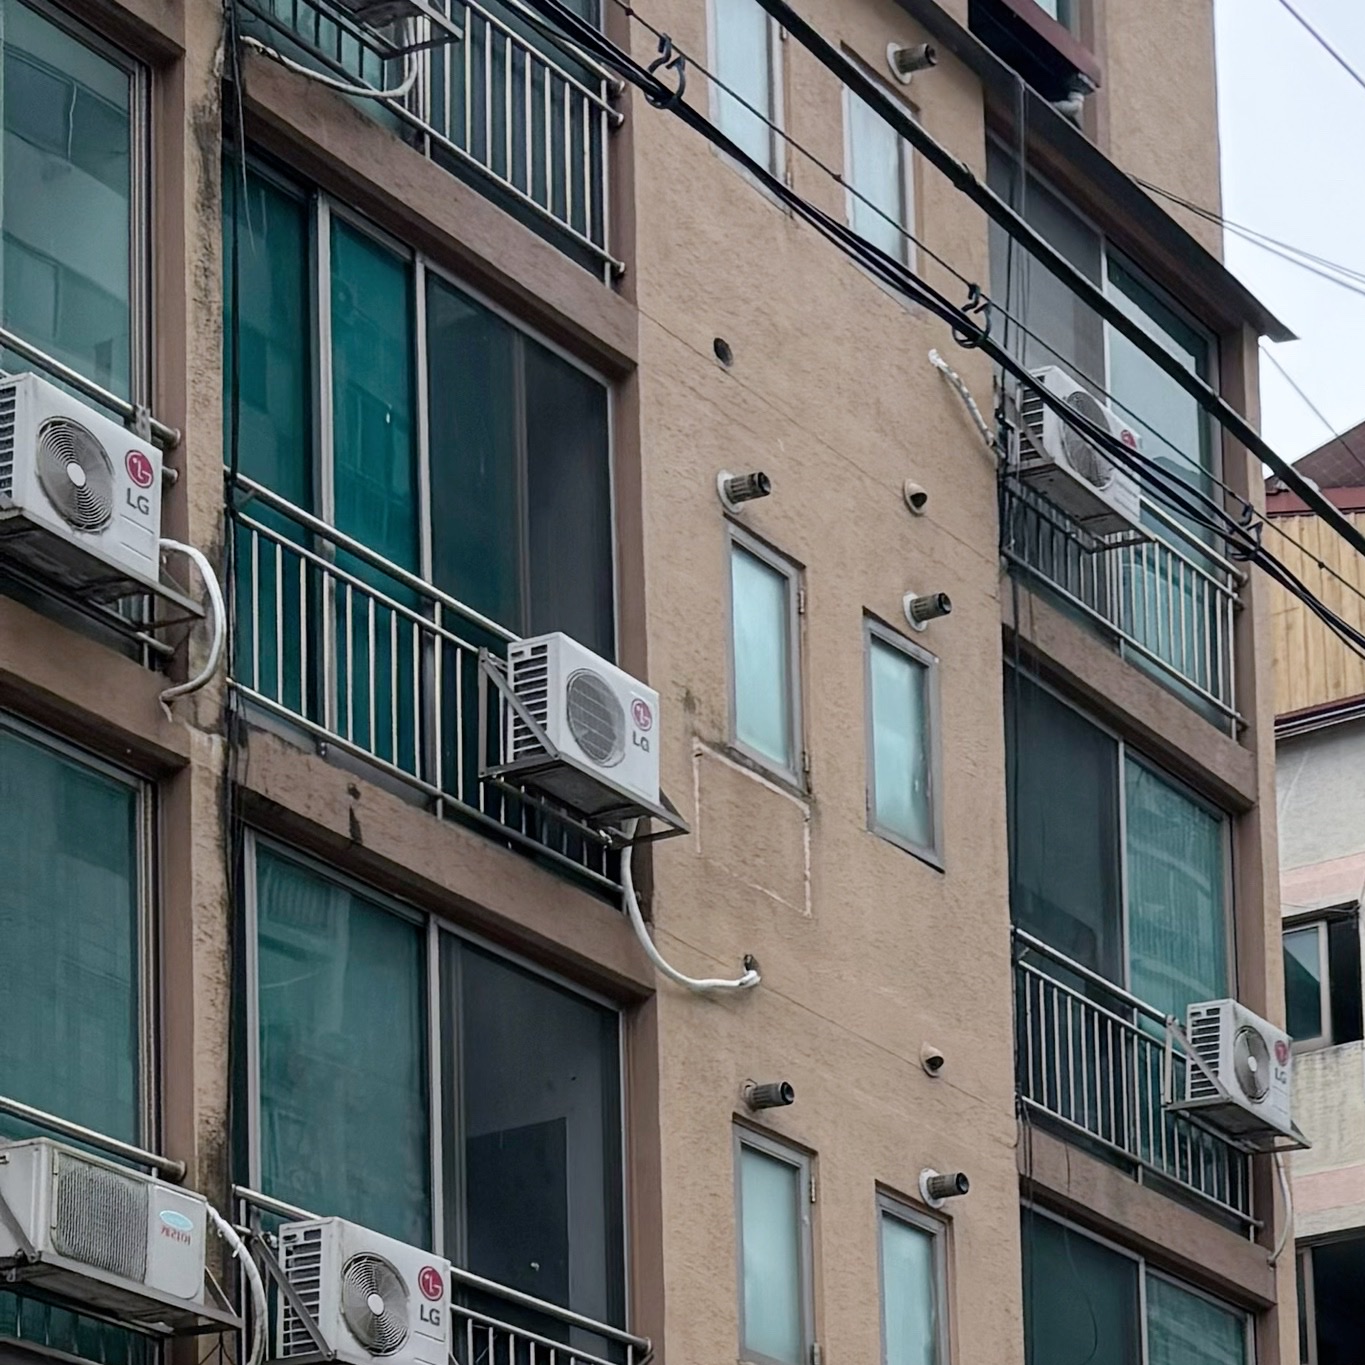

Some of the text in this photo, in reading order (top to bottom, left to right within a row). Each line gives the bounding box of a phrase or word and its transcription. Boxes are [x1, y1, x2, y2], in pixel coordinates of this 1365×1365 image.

[126, 487, 150, 516] LG
[632, 730, 650, 753] LG
[420, 1303, 441, 1327] LG
